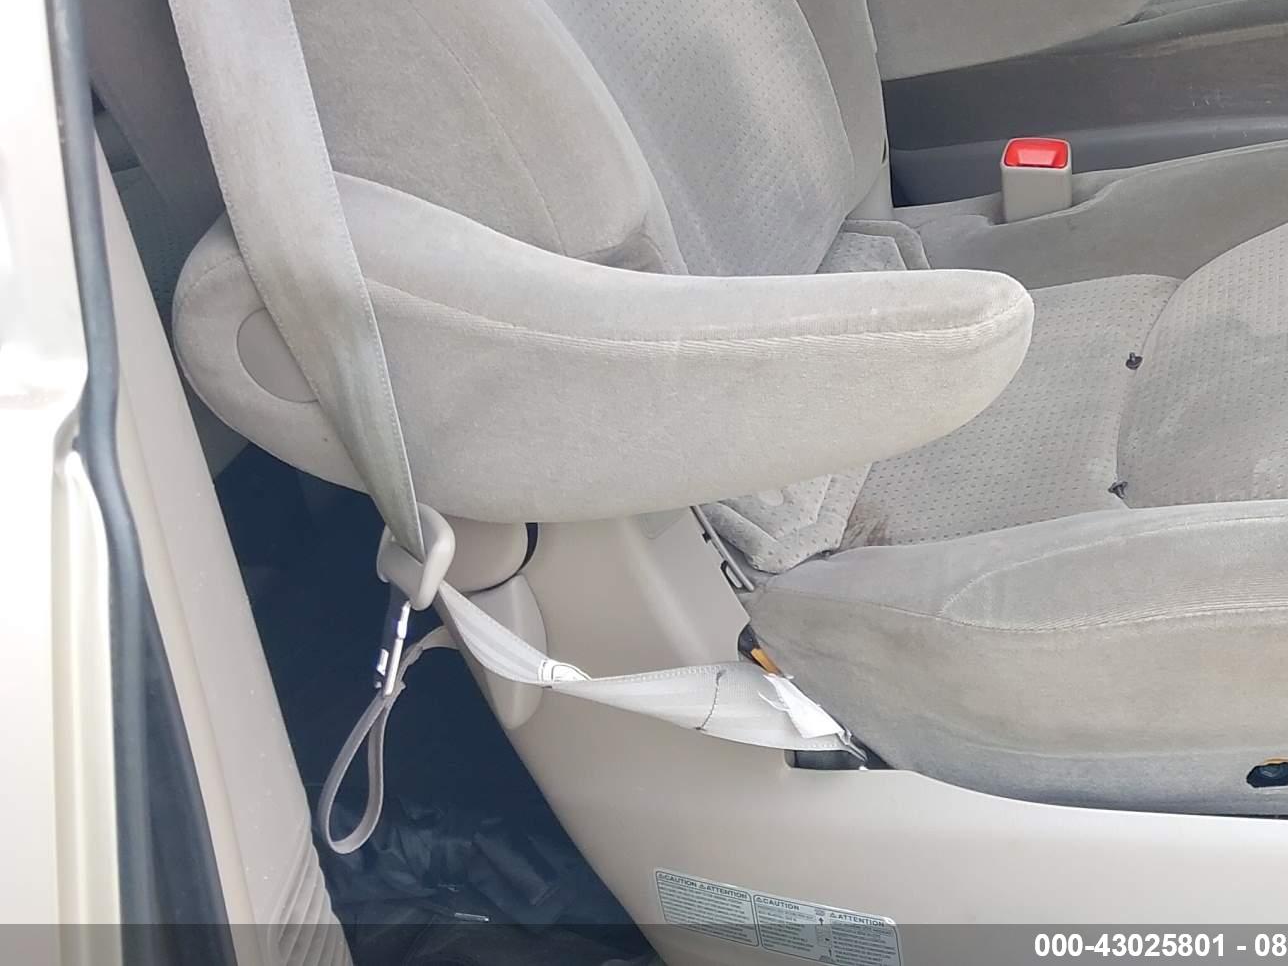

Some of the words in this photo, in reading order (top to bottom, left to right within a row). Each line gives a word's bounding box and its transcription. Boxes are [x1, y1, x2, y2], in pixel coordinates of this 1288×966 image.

[664, 874, 698, 888] CAUTION
[706, 885, 748, 900] ATTENTION
[763, 897, 800, 911] CAUTION
[837, 913, 885, 927] ATTENTION
